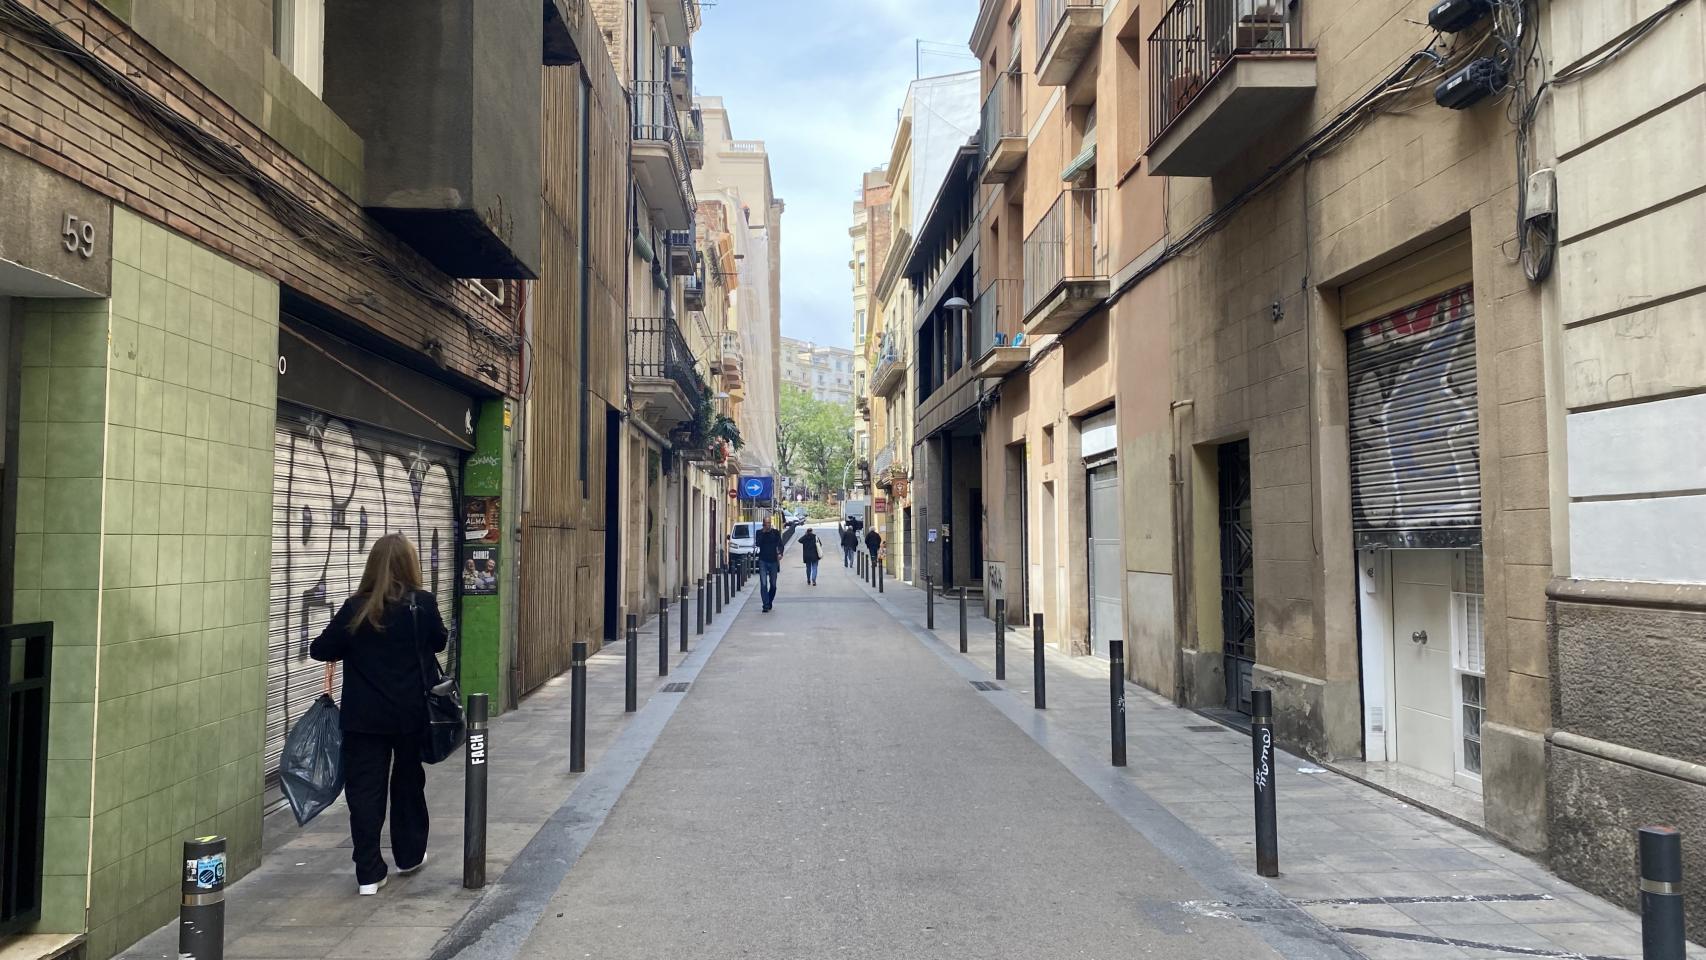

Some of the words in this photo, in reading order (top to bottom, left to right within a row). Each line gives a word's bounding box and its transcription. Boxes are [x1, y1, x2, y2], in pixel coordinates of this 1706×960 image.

[62, 212, 95, 258] 59
[465, 517, 487, 526] ALMA
[470, 733, 485, 766] FACH
